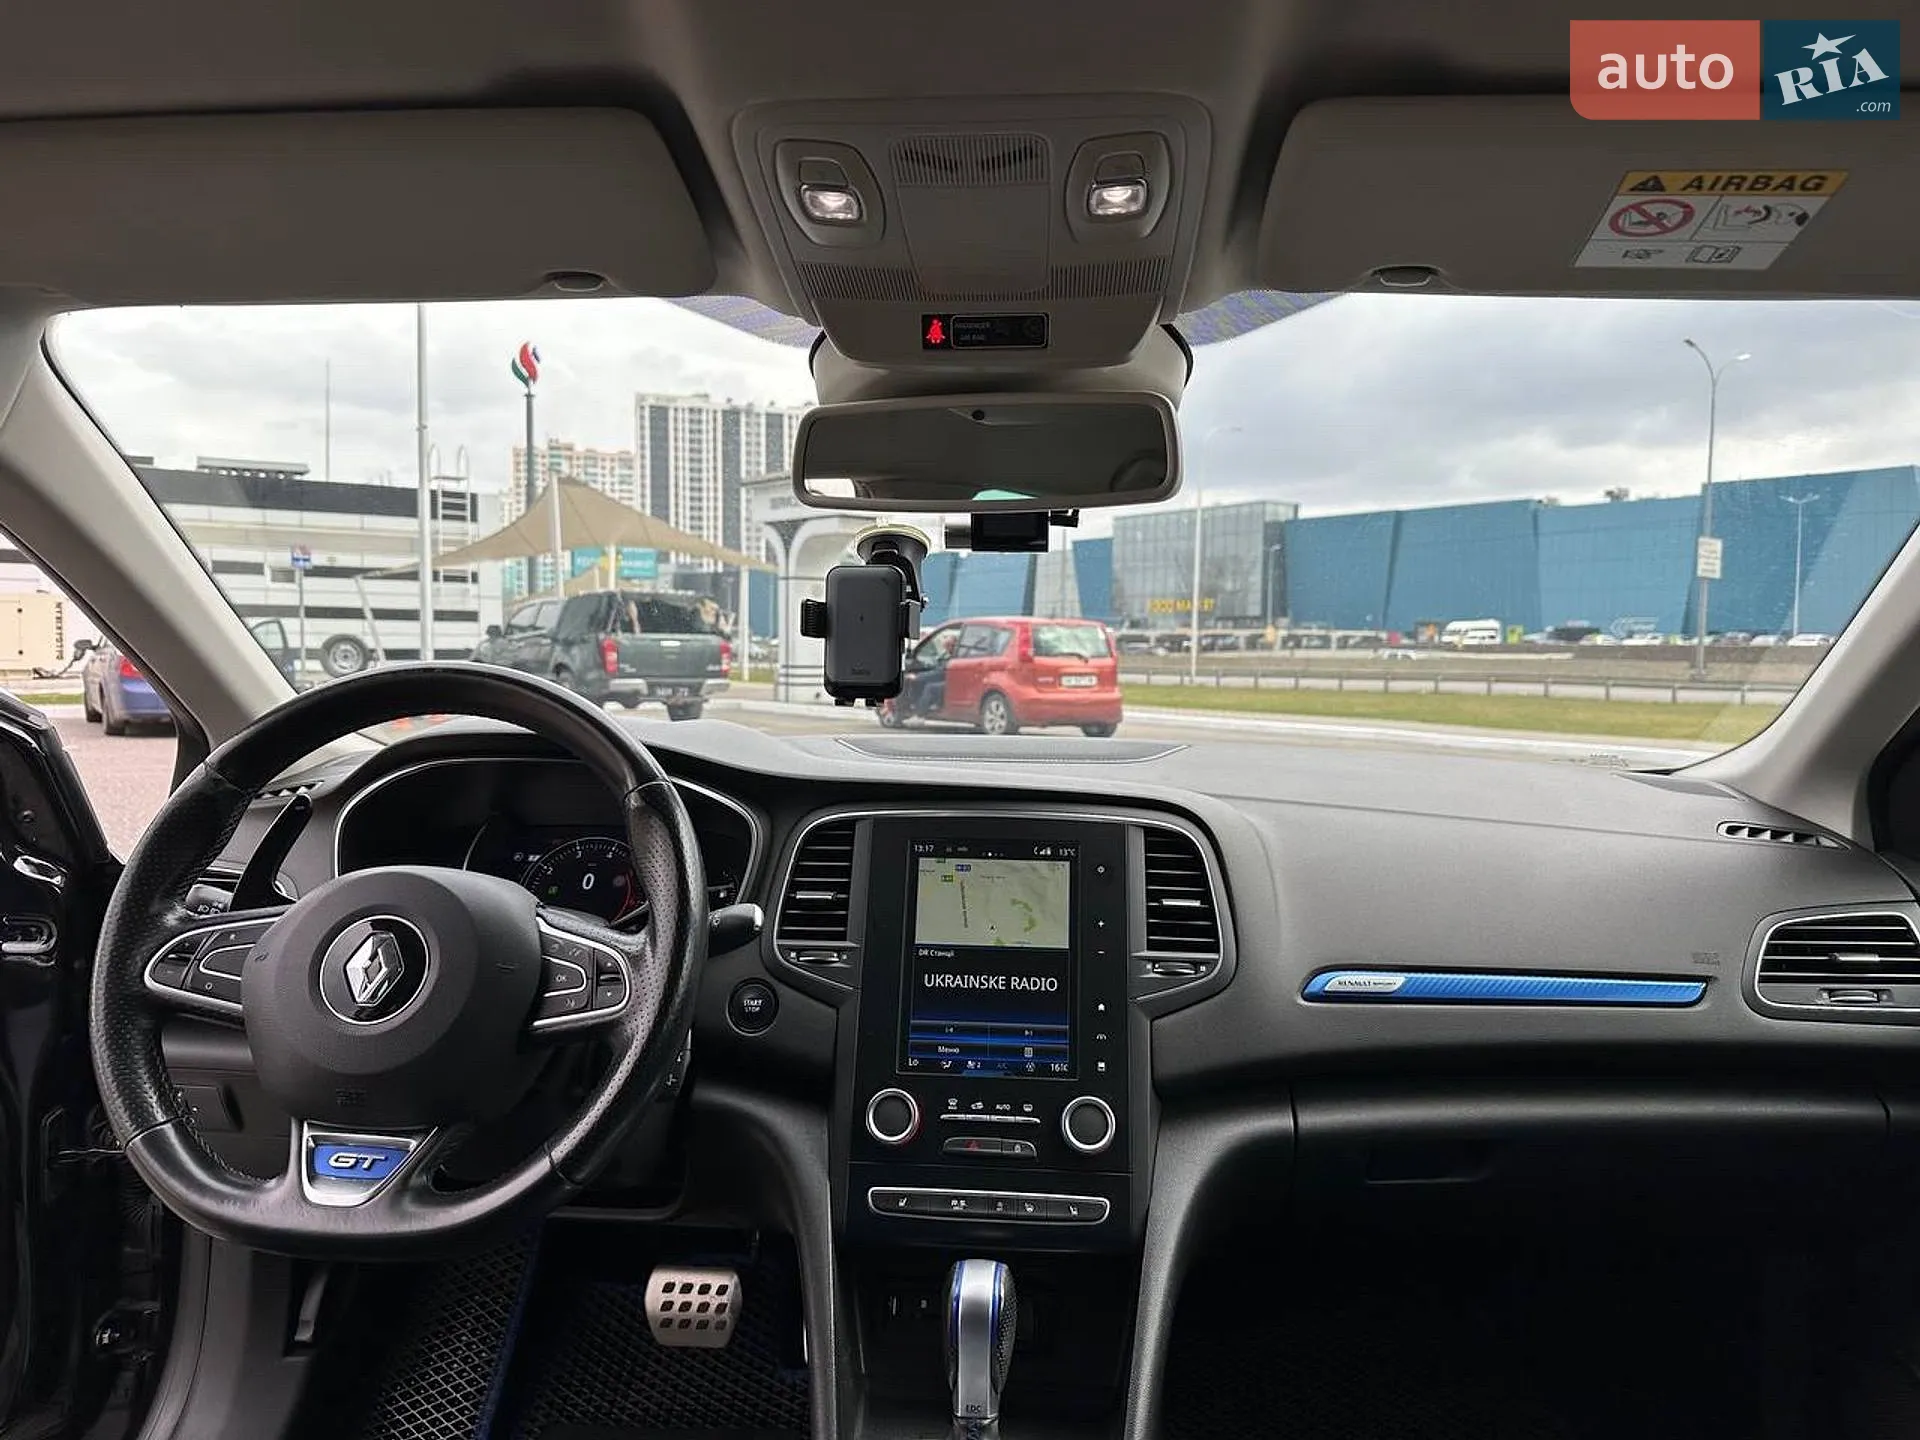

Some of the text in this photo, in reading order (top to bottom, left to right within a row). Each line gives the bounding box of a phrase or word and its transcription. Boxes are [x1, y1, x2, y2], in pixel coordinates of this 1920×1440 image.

[1681, 175, 1829, 192] AIRBAG
[582, 873, 595, 890] 0
[924, 973, 1058, 992] UKRAINSKE RADIO
[328, 1151, 386, 1170] GT
